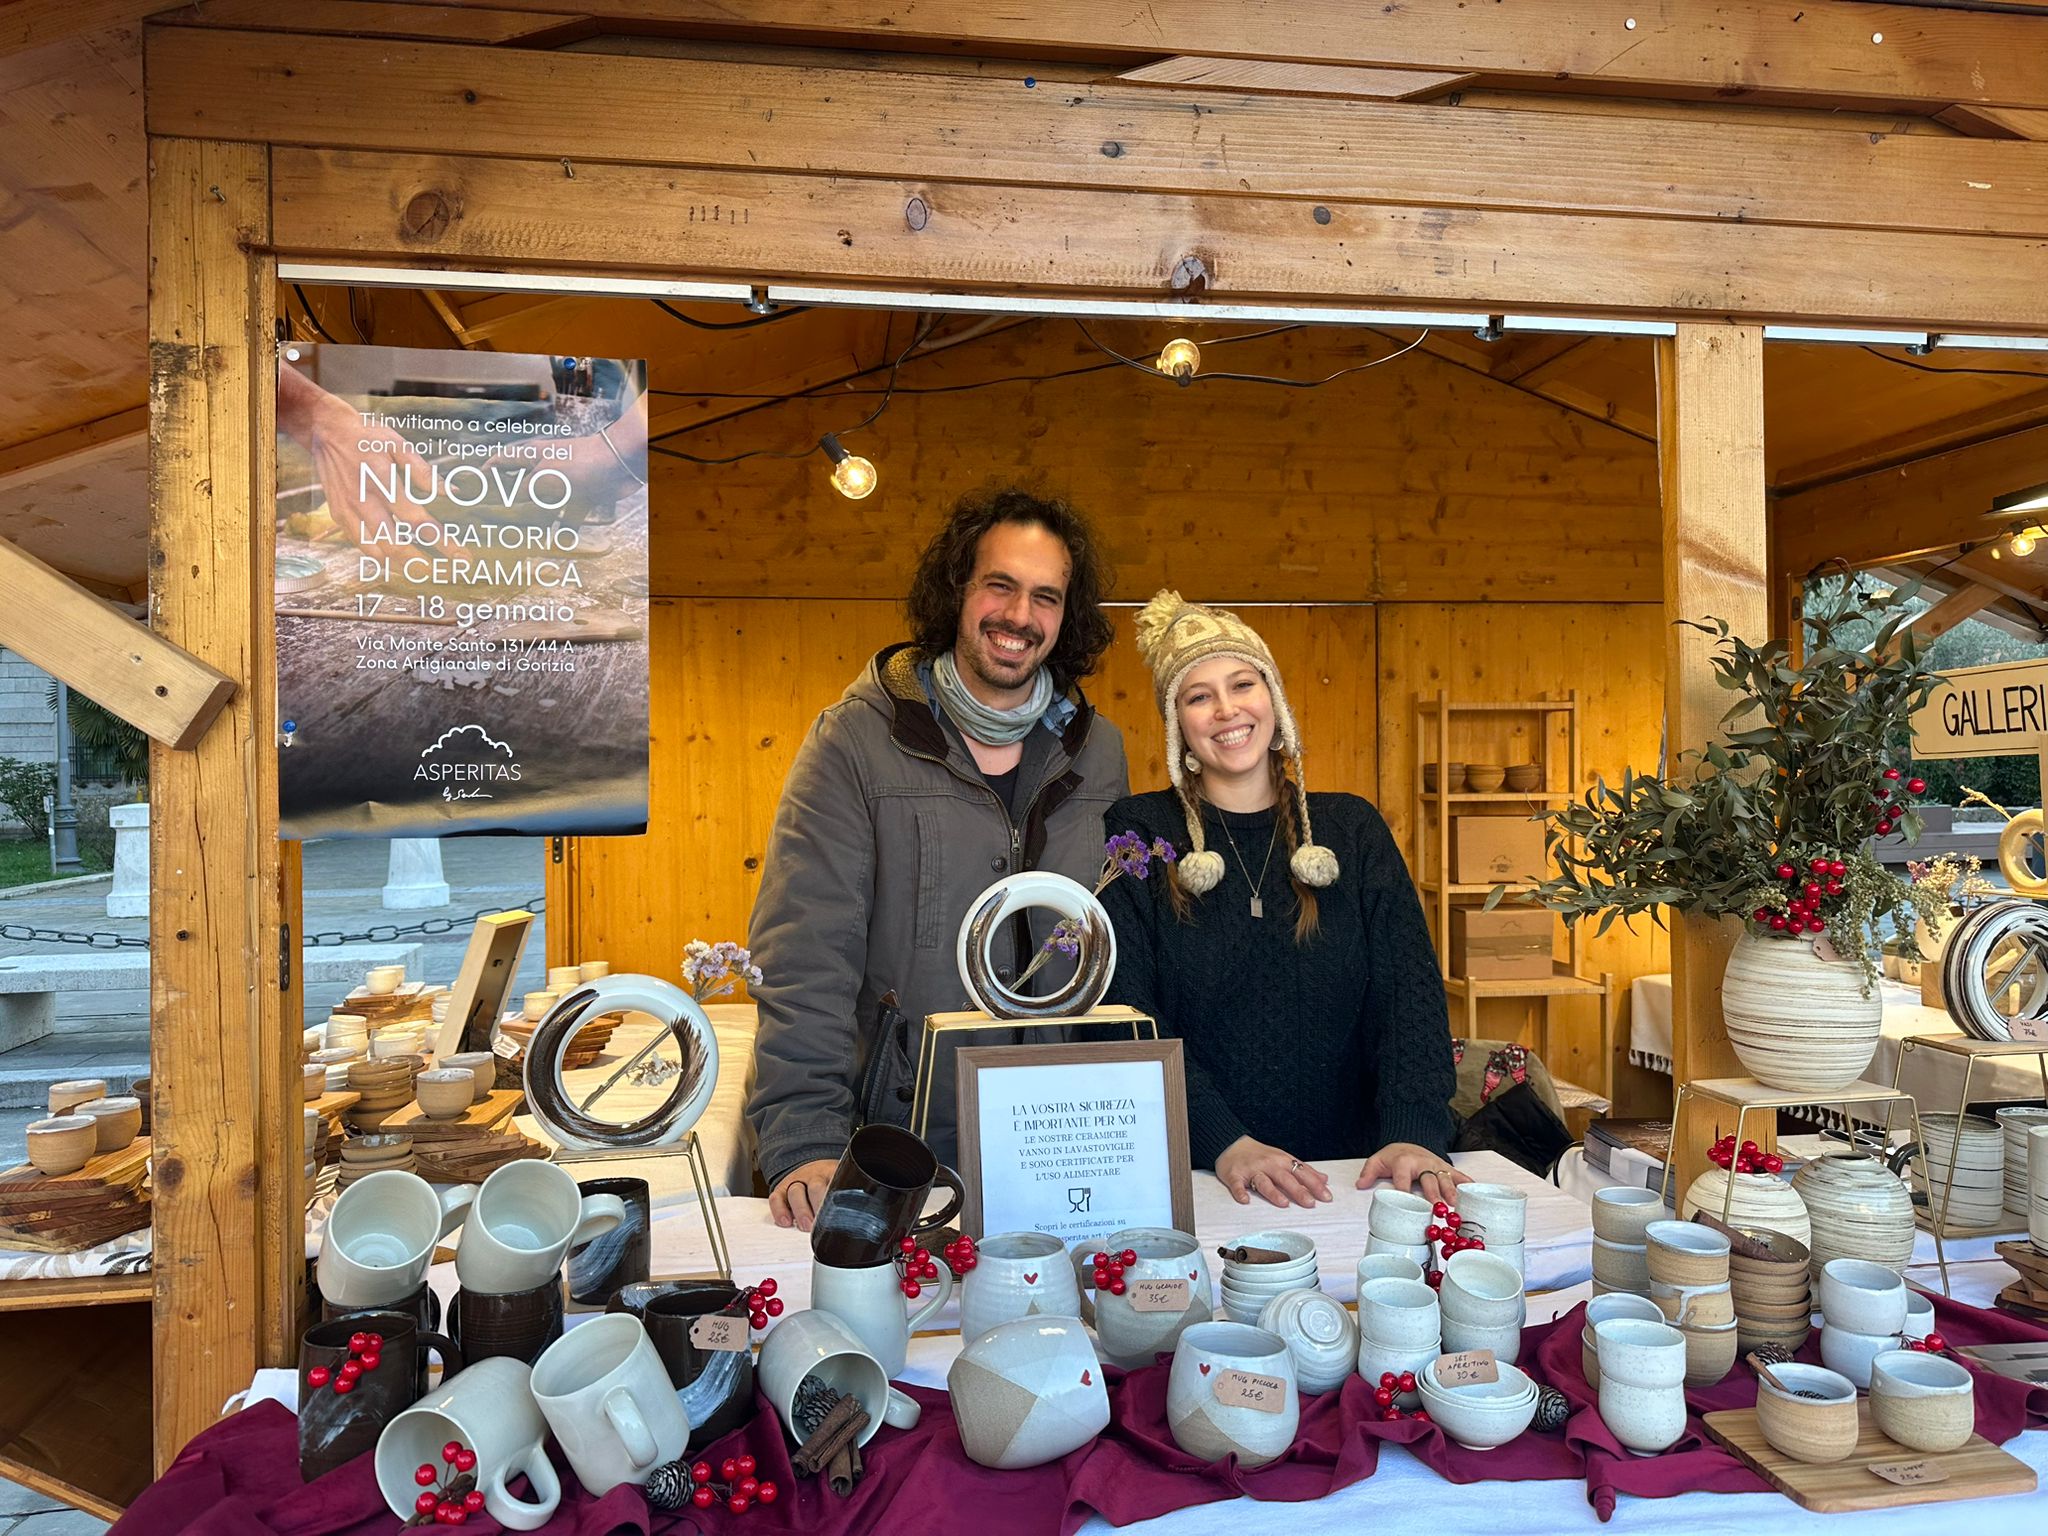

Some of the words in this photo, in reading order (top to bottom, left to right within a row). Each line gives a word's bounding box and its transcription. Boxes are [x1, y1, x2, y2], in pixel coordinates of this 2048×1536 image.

[359, 412, 375, 428] Ti
[380, 412, 464, 432] invitiamo
[468, 419, 480, 432] a
[484, 418, 572, 436] celebrare
[358, 438, 396, 454] con
[402, 438, 433, 454] noi
[438, 438, 536, 460] l'apertura
[542, 444, 573, 460] del
[359, 462, 572, 510] NUOVO
[360, 520, 580, 551] LABORATORIO
[359, 556, 390, 582] DI
[403, 556, 583, 588] CERAMICA
[355, 593, 384, 617] 17
[416, 595, 445, 618] 18
[456, 600, 574, 628] gennaio
[356, 636, 384, 650] Via
[390, 636, 443, 652] Monte
[448, 637, 496, 653] Santo
[502, 636, 558, 657] 131/44
[562, 640, 574, 654] A
[356, 656, 398, 670] Zona
[402, 656, 491, 674] Artigianale
[496, 656, 511, 672] di
[516, 658, 576, 672] Gorizia
[1942, 684, 2048, 736] GALLERI
[414, 763, 522, 781] ASPERITAS
[1012, 1104, 1027, 1116] LA
[1031, 1102, 1075, 1114] VOSTRA
[1079, 1098, 1135, 1112] SICUREZZA
[1024, 1116, 1091, 1131] IMPORTANTE
[1094, 1115, 1115, 1127] PER
[1118, 1114, 1136, 1126] NOI
[1024, 1136, 1036, 1144] LE
[1038, 1134, 1074, 1144] NOSTRE
[1075, 1130, 1128, 1140] CERAMICHE
[1019, 1148, 1050, 1157] VANNO
[1065, 1142, 1135, 1154] LAVASTOVIGLIE
[1029, 1160, 1053, 1169] SONO
[1055, 1156, 1114, 1167] CERTIFICATE
[1116, 1155, 1134, 1163] PER
[1036, 1172, 1061, 1181] L'USO
[1063, 1168, 1120, 1179] ALIMENTARE
[1034, 1223, 1058, 1232] Scopri
[1069, 1220, 1115, 1229] certificazioni
[1148, 1293, 1169, 1304] 35€
[708, 1331, 730, 1343] 25€
[1447, 1360, 1489, 1370] APERITIVO
[1232, 1374, 1248, 1384] MUG
[1241, 1388, 1264, 1401] 25€
